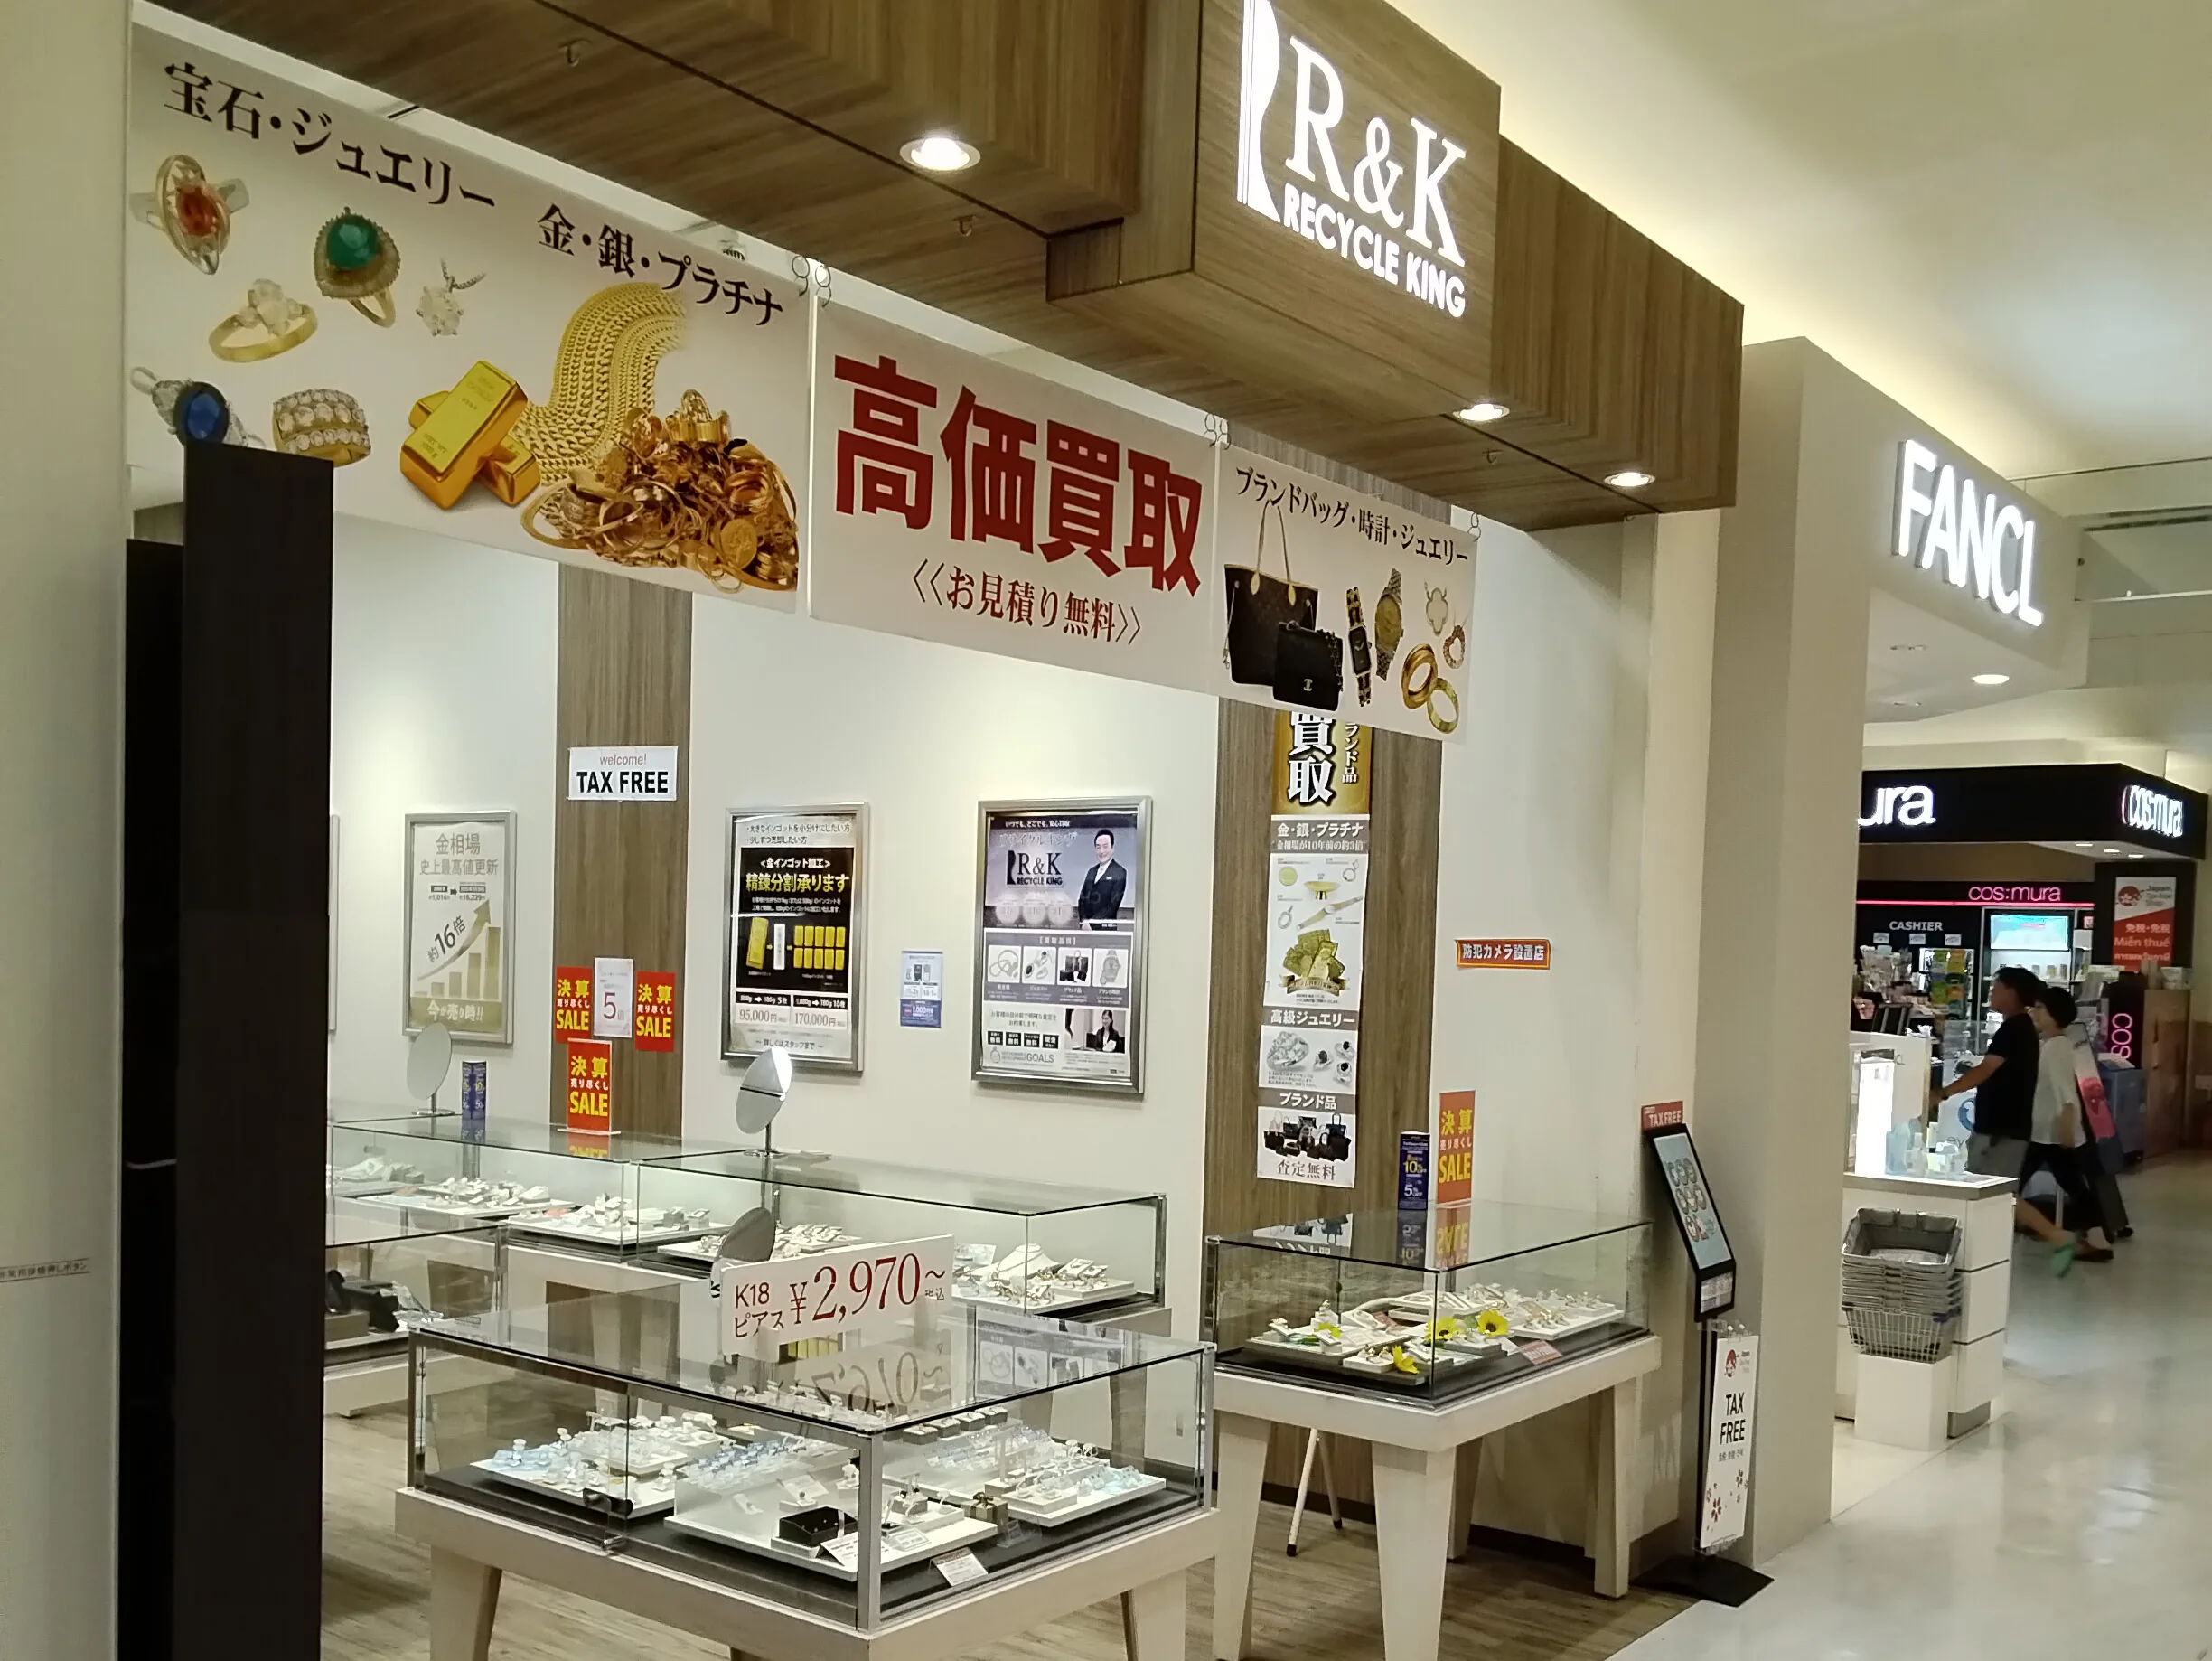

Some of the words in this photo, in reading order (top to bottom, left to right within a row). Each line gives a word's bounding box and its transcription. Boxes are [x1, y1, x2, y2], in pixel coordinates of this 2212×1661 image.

[164, 63, 496, 208] 宝石・ジュエリー
[1285, 36, 1466, 267] R&K
[1283, 183, 1400, 285] RECYCLE
[1406, 252, 1466, 317] KING
[538, 204, 783, 327] 金・銀・プラチナ
[834, 355, 1202, 597] 高価買取
[1236, 466, 1468, 565] ブランドバッグ・時計・ジュエリー
[1898, 439, 2043, 626] FANCL
[599, 753, 647, 765] welcome!
[1288, 711, 1333, 803] 買取
[576, 771, 613, 793] TAX
[619, 771, 669, 793] FREE
[1277, 822, 1364, 838] 金・銀・プラチナ
[436, 833, 480, 855] 金相場
[419, 859, 499, 876] 史上最高値更新
[1017, 852, 1062, 875] R&K
[1017, 877, 1045, 886] RECYCLE
[1046, 877, 1063, 886] KING
[1968, 886, 2061, 902] cos:mura
[1889, 921, 1943, 932] CASHIER
[1462, 944, 1544, 961] 防犯カメラ設置店
[557, 979, 590, 998] 決算
[638, 983, 672, 1004] 決算
[556, 1009, 589, 1030] SALE
[636, 1015, 672, 1037] SALE
[1270, 1009, 1355, 1027] 高級ジュエリー
[570, 1056, 608, 1079] 決算
[1026, 1053, 1054, 1063] GOALS
[570, 1091, 608, 1117] SALE
[1279, 1093, 1337, 1110] ブランド品
[1441, 1109, 1472, 1136] 決算
[1277, 1159, 1336, 1181] 査定無料
[1439, 1152, 1471, 1184] SALE
[736, 1282, 769, 1309] K18
[734, 1310, 784, 1337] ピアス
[1725, 1392, 1745, 1416] TAX
[1720, 1419, 1746, 1445] FREE
